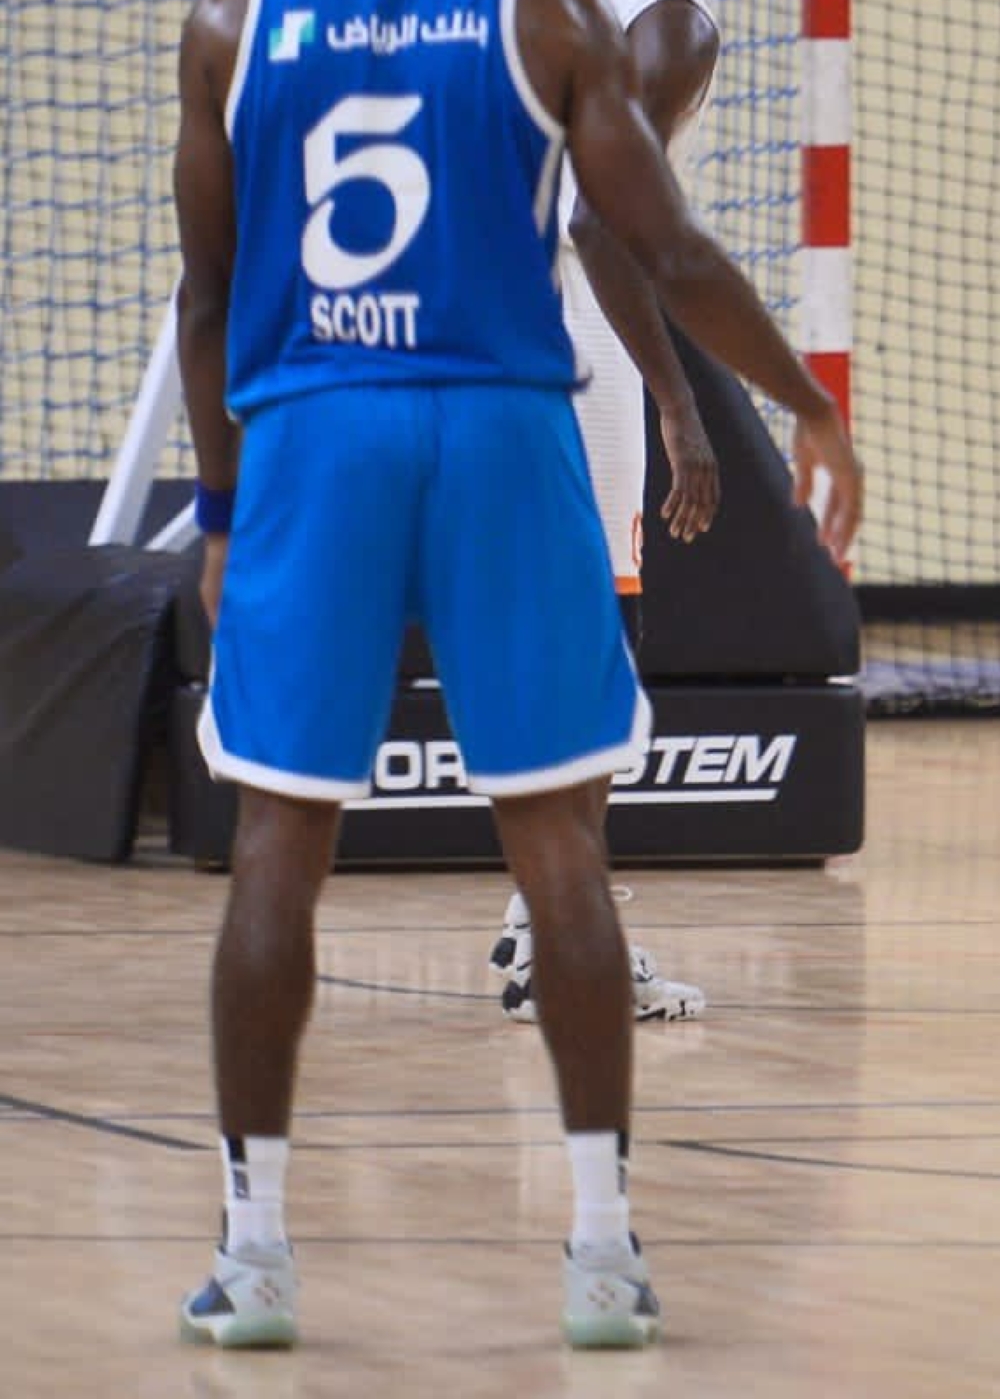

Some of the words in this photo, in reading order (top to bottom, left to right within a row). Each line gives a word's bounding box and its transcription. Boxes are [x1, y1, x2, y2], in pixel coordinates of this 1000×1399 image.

[327, 13, 418, 56] الرياض
[421, 10, 489, 48] بنك
[300, 93, 431, 290] 5
[310, 293, 420, 347] SCOTT
